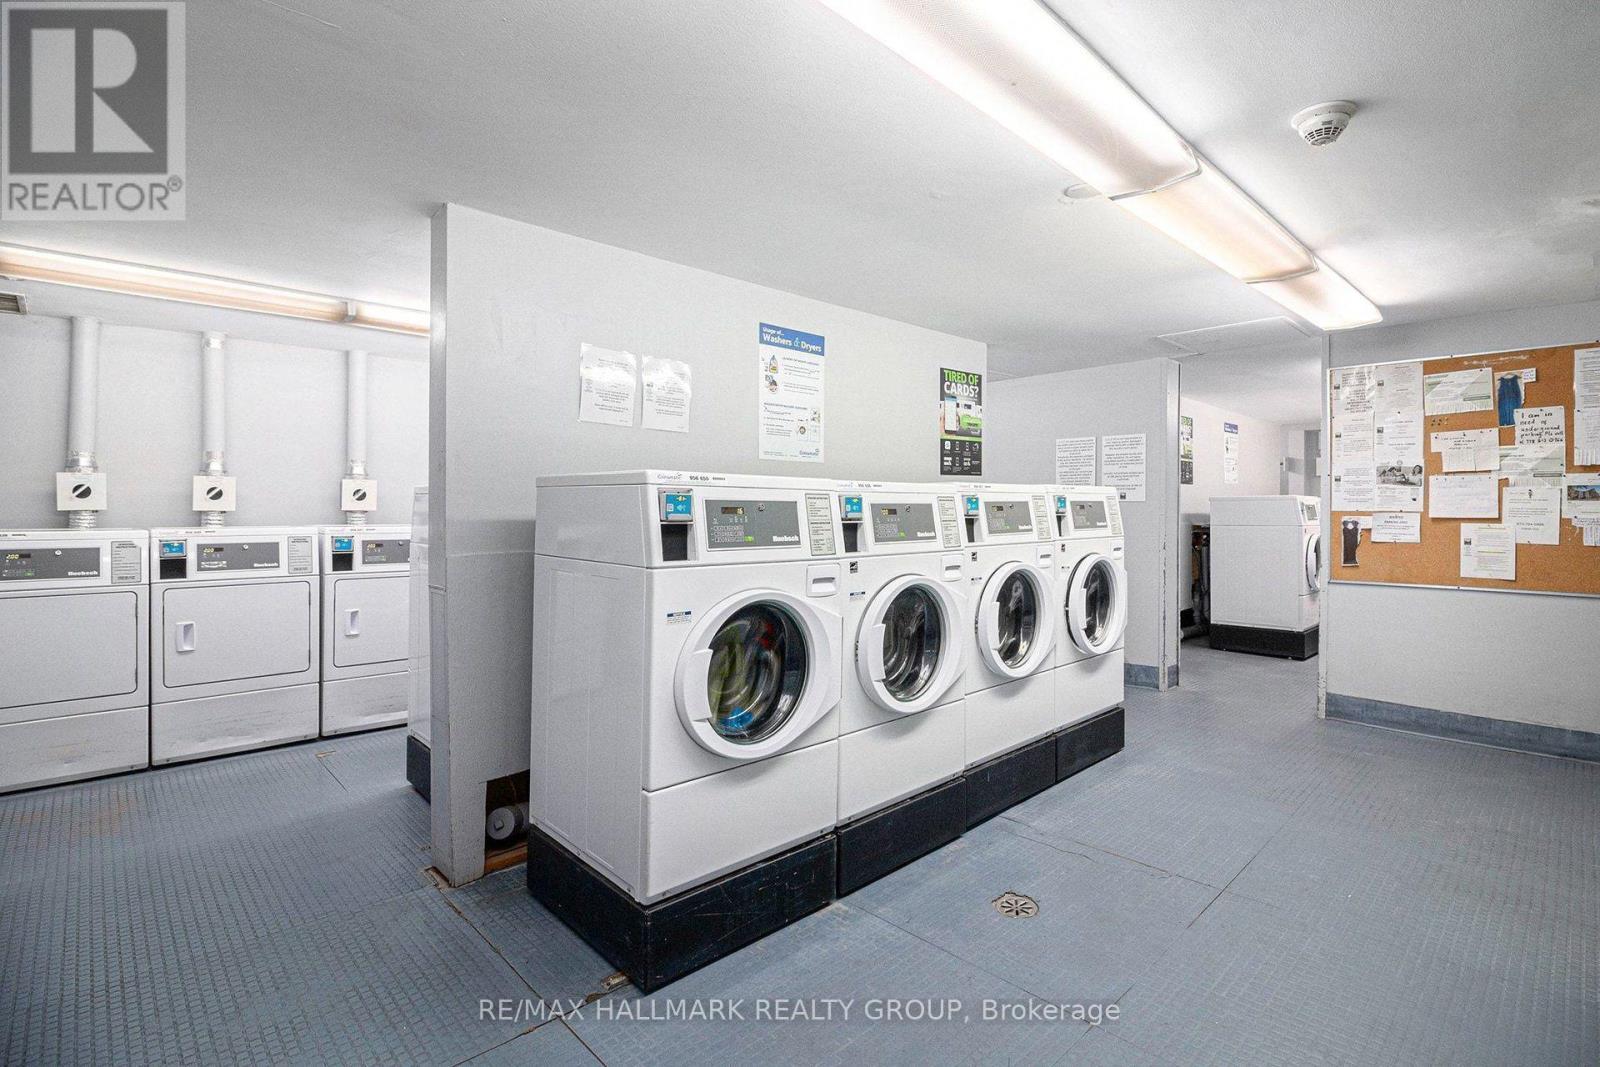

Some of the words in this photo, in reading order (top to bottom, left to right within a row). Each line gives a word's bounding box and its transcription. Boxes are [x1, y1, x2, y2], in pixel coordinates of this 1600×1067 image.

[763, 334, 792, 347] Washers
[801, 341, 822, 353] Dryers
[944, 369, 967, 385] TIRED
[968, 374, 979, 386] OF
[944, 381, 980, 398] CARDS?
